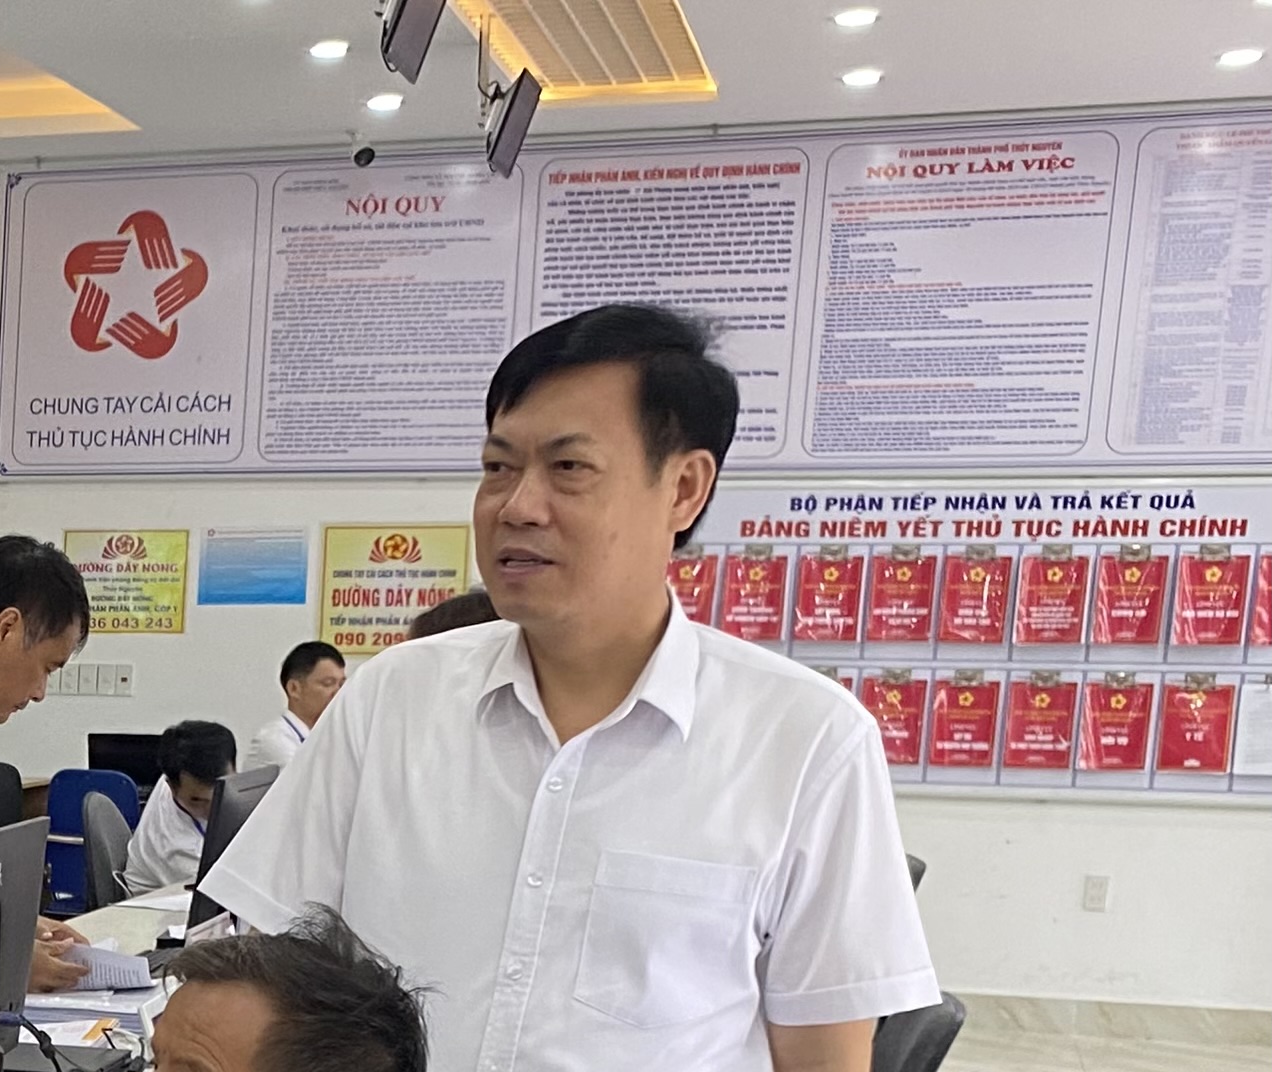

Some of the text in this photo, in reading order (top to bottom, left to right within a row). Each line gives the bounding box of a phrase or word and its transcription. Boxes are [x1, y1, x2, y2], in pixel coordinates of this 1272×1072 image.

[866, 154, 1075, 181] NỘI QUY LÀM VIỆC
[345, 193, 446, 219] NỘI QUY
[29, 391, 231, 415] CHUNG TAY CẢI CÁCH
[26, 424, 230, 450] THỦ TỤC HÀNH CHÍNH
[790, 488, 1196, 515] BỘ PHẬN TIẾP NHẬN VÀ TRẢ KẾT QUẢ
[740, 513, 1248, 542] BẢNG NIÊM YẾT THỦ TỤC HÀNH CHÍNH
[116, 561, 139, 573] DÂY
[332, 582, 380, 607] ĐƯỜNG
[385, 583, 413, 607] DÂY
[89, 617, 173, 629] 36 043 243
[334, 632, 366, 646] 090
